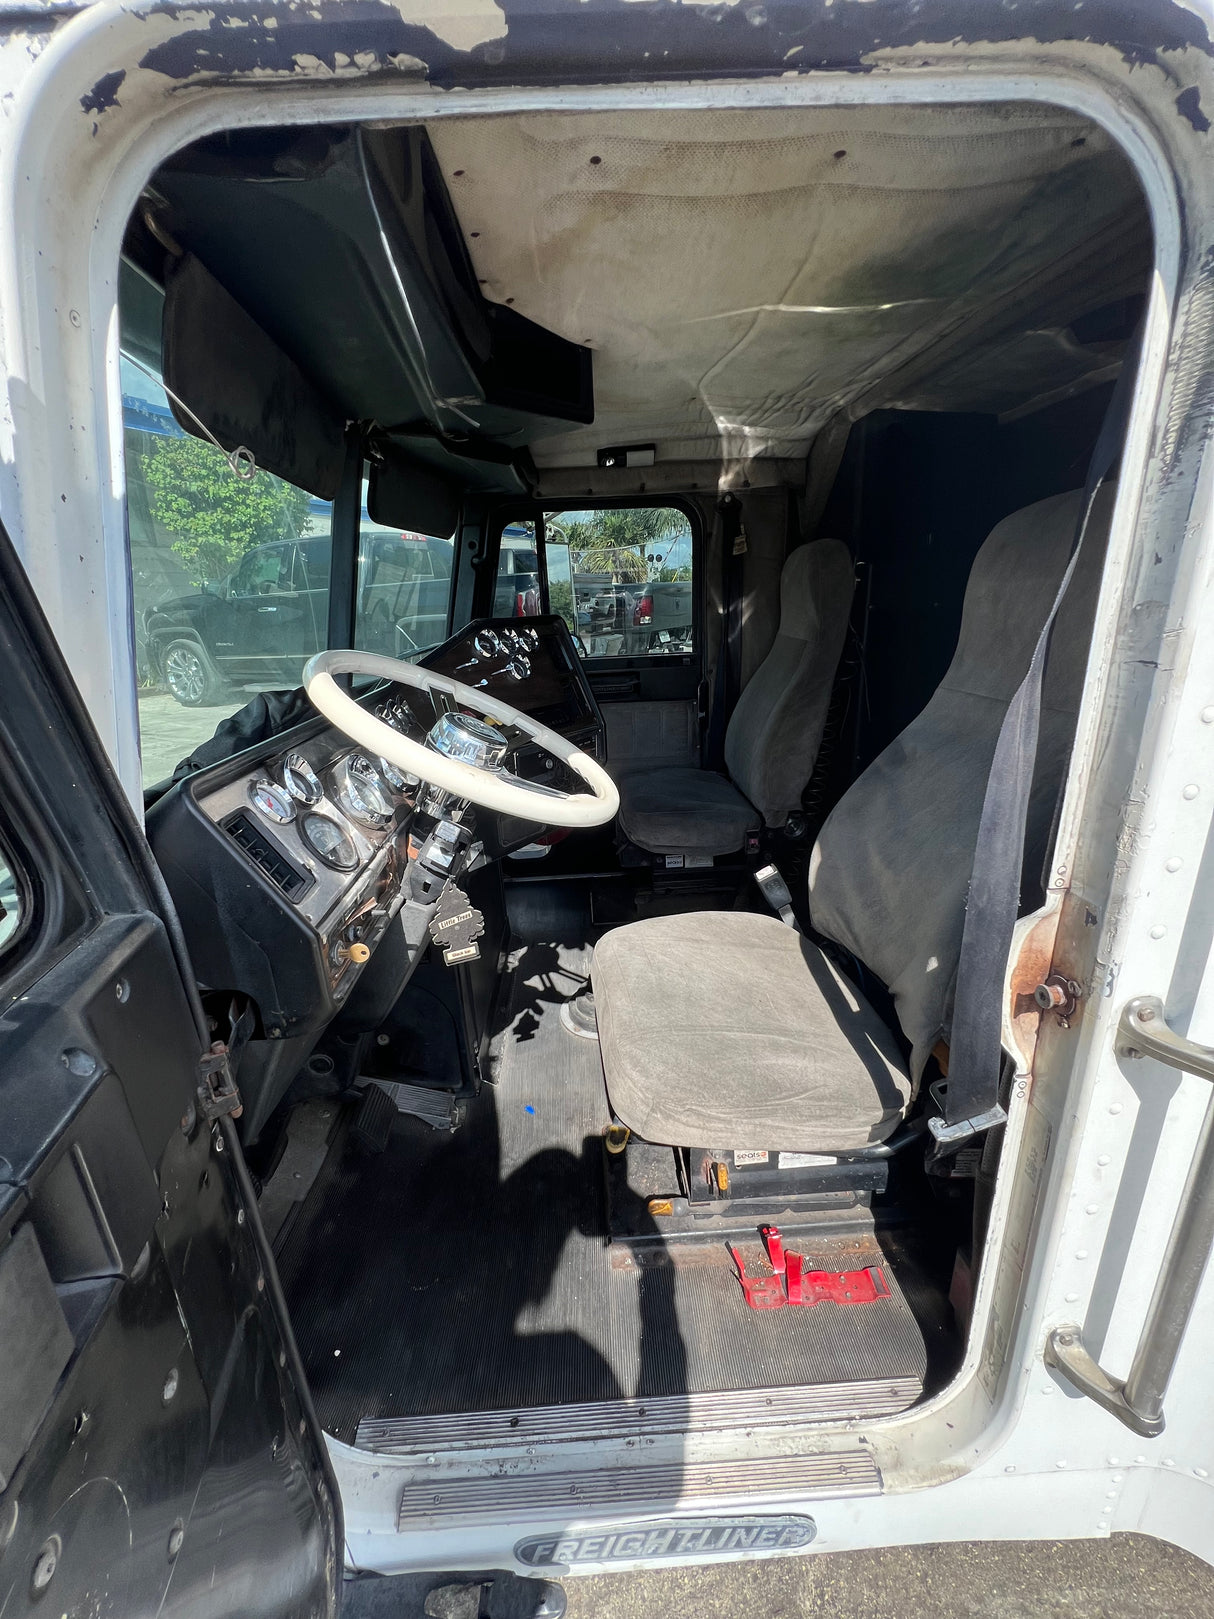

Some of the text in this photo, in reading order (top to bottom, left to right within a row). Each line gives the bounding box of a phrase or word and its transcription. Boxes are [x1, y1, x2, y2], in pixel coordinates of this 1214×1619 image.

[441, 913, 471, 928] Little Trees
[531, 1524, 808, 1563] FREIGHTLINER
